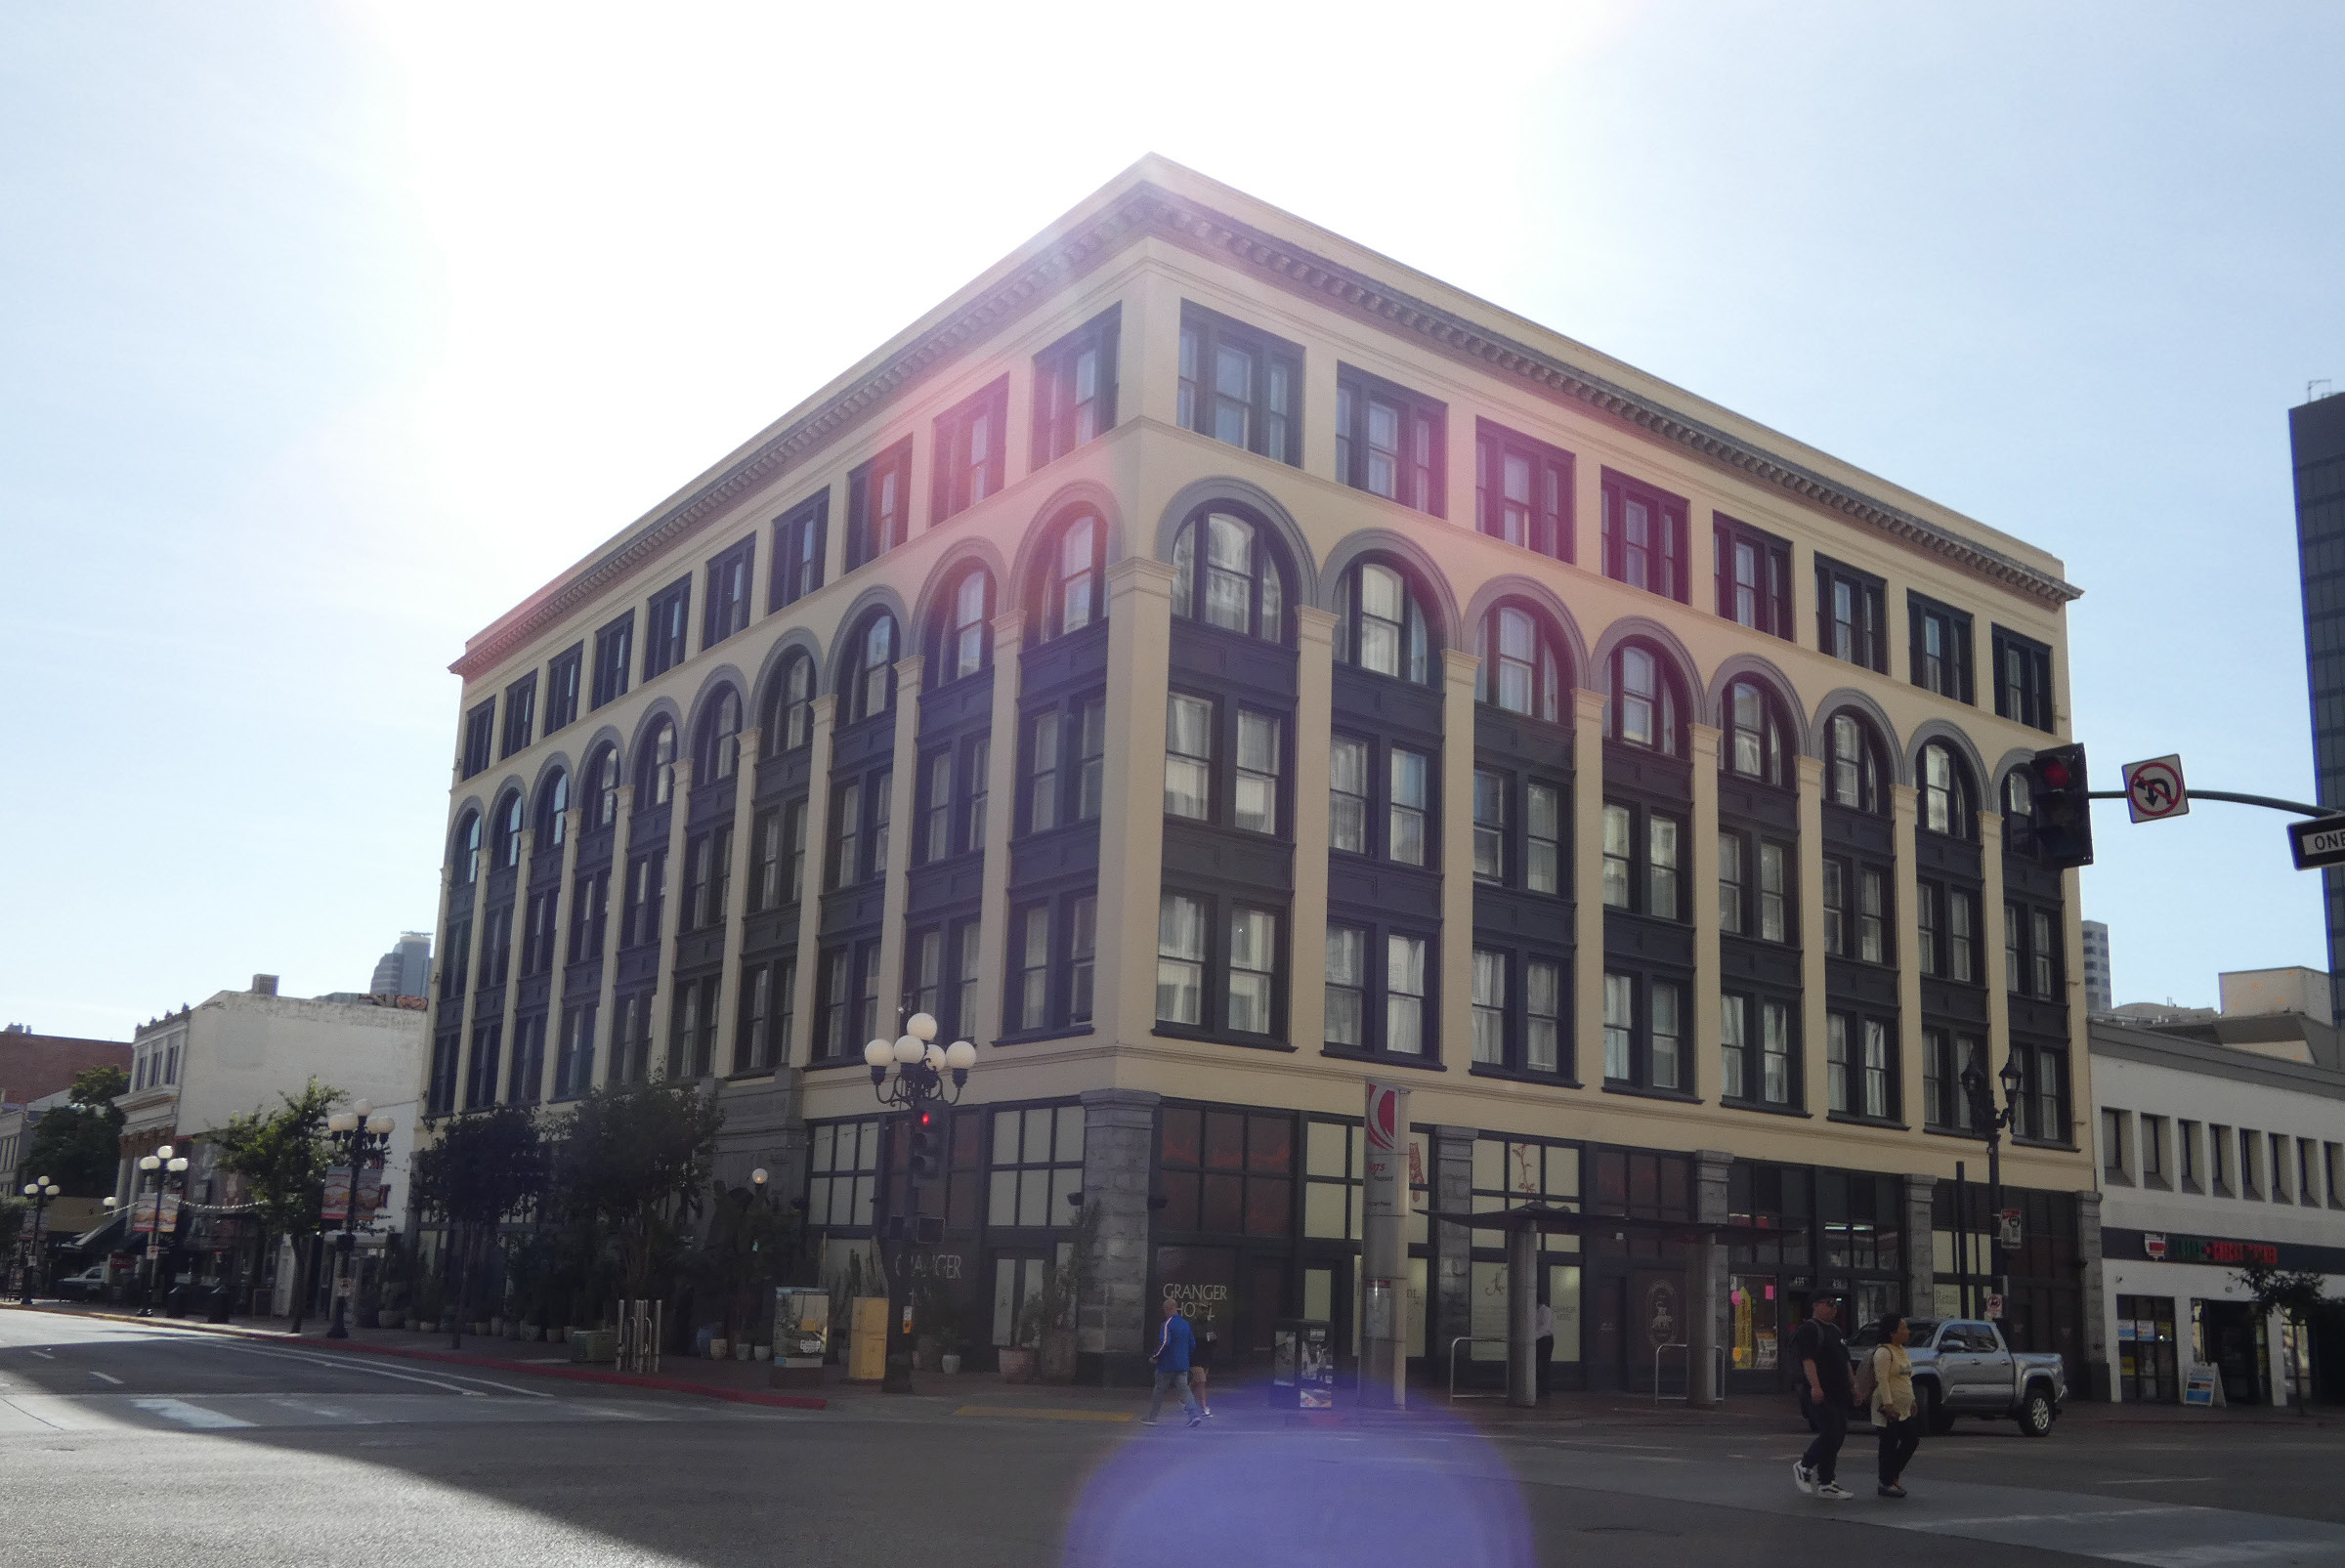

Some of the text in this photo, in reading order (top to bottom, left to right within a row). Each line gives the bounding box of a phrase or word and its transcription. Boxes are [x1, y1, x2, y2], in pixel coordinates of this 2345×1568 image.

[2315, 831, 2345, 850] ONE
[895, 1253, 961, 1279] GAGER
[1163, 1283, 1228, 1300] GRANGER
[1174, 1301, 1215, 1318] HOL
